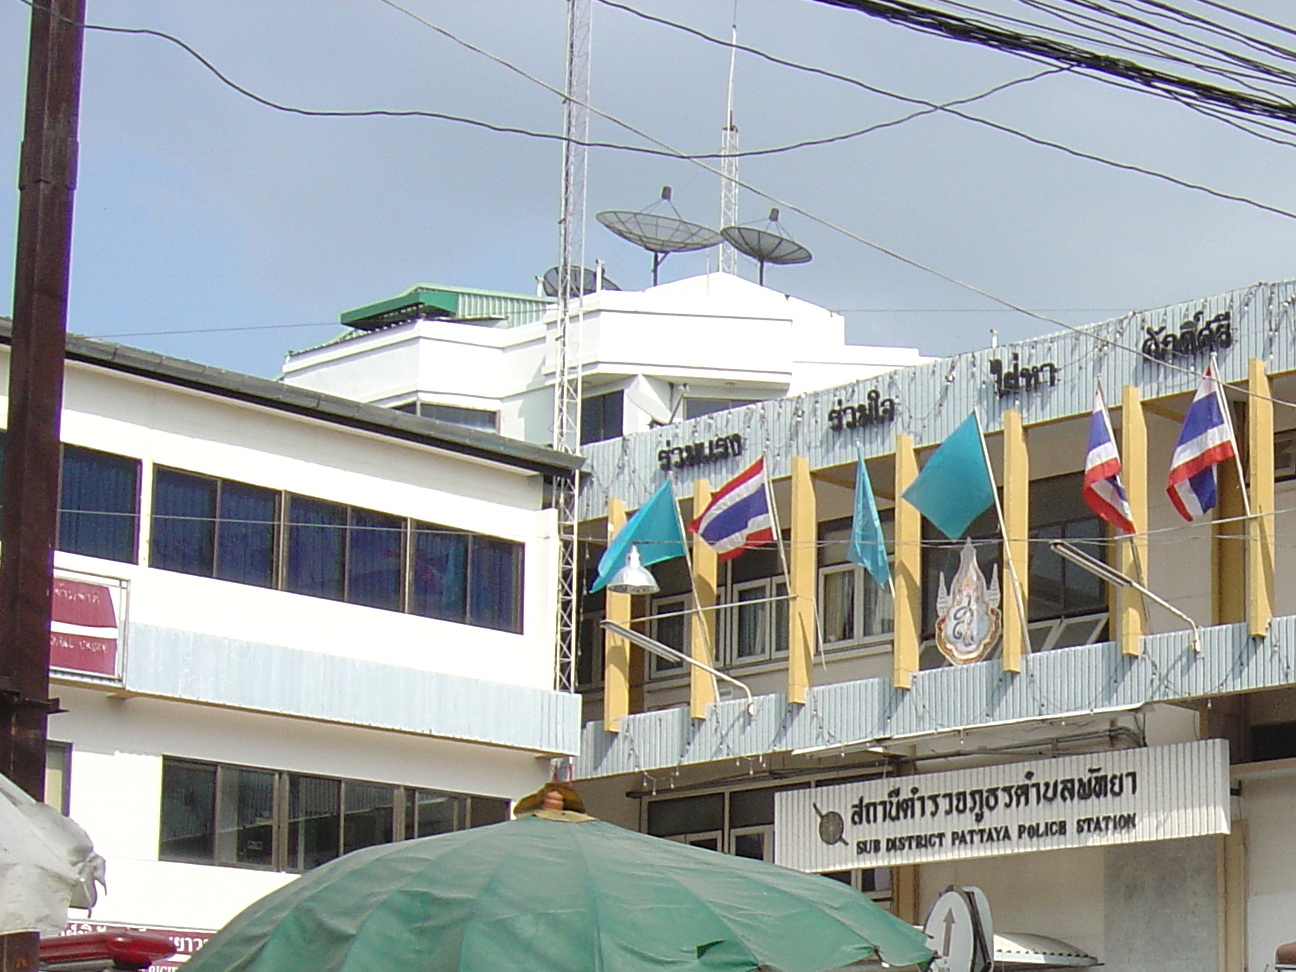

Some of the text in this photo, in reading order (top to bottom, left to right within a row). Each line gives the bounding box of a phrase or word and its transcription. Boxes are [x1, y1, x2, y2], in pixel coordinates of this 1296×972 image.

[851, 767, 1138, 825] สถานีตำรวจภูธรตำบลพัทยา
[857, 812, 1137, 856] SUB DISTRICT PATTAYA POLICE STATION
